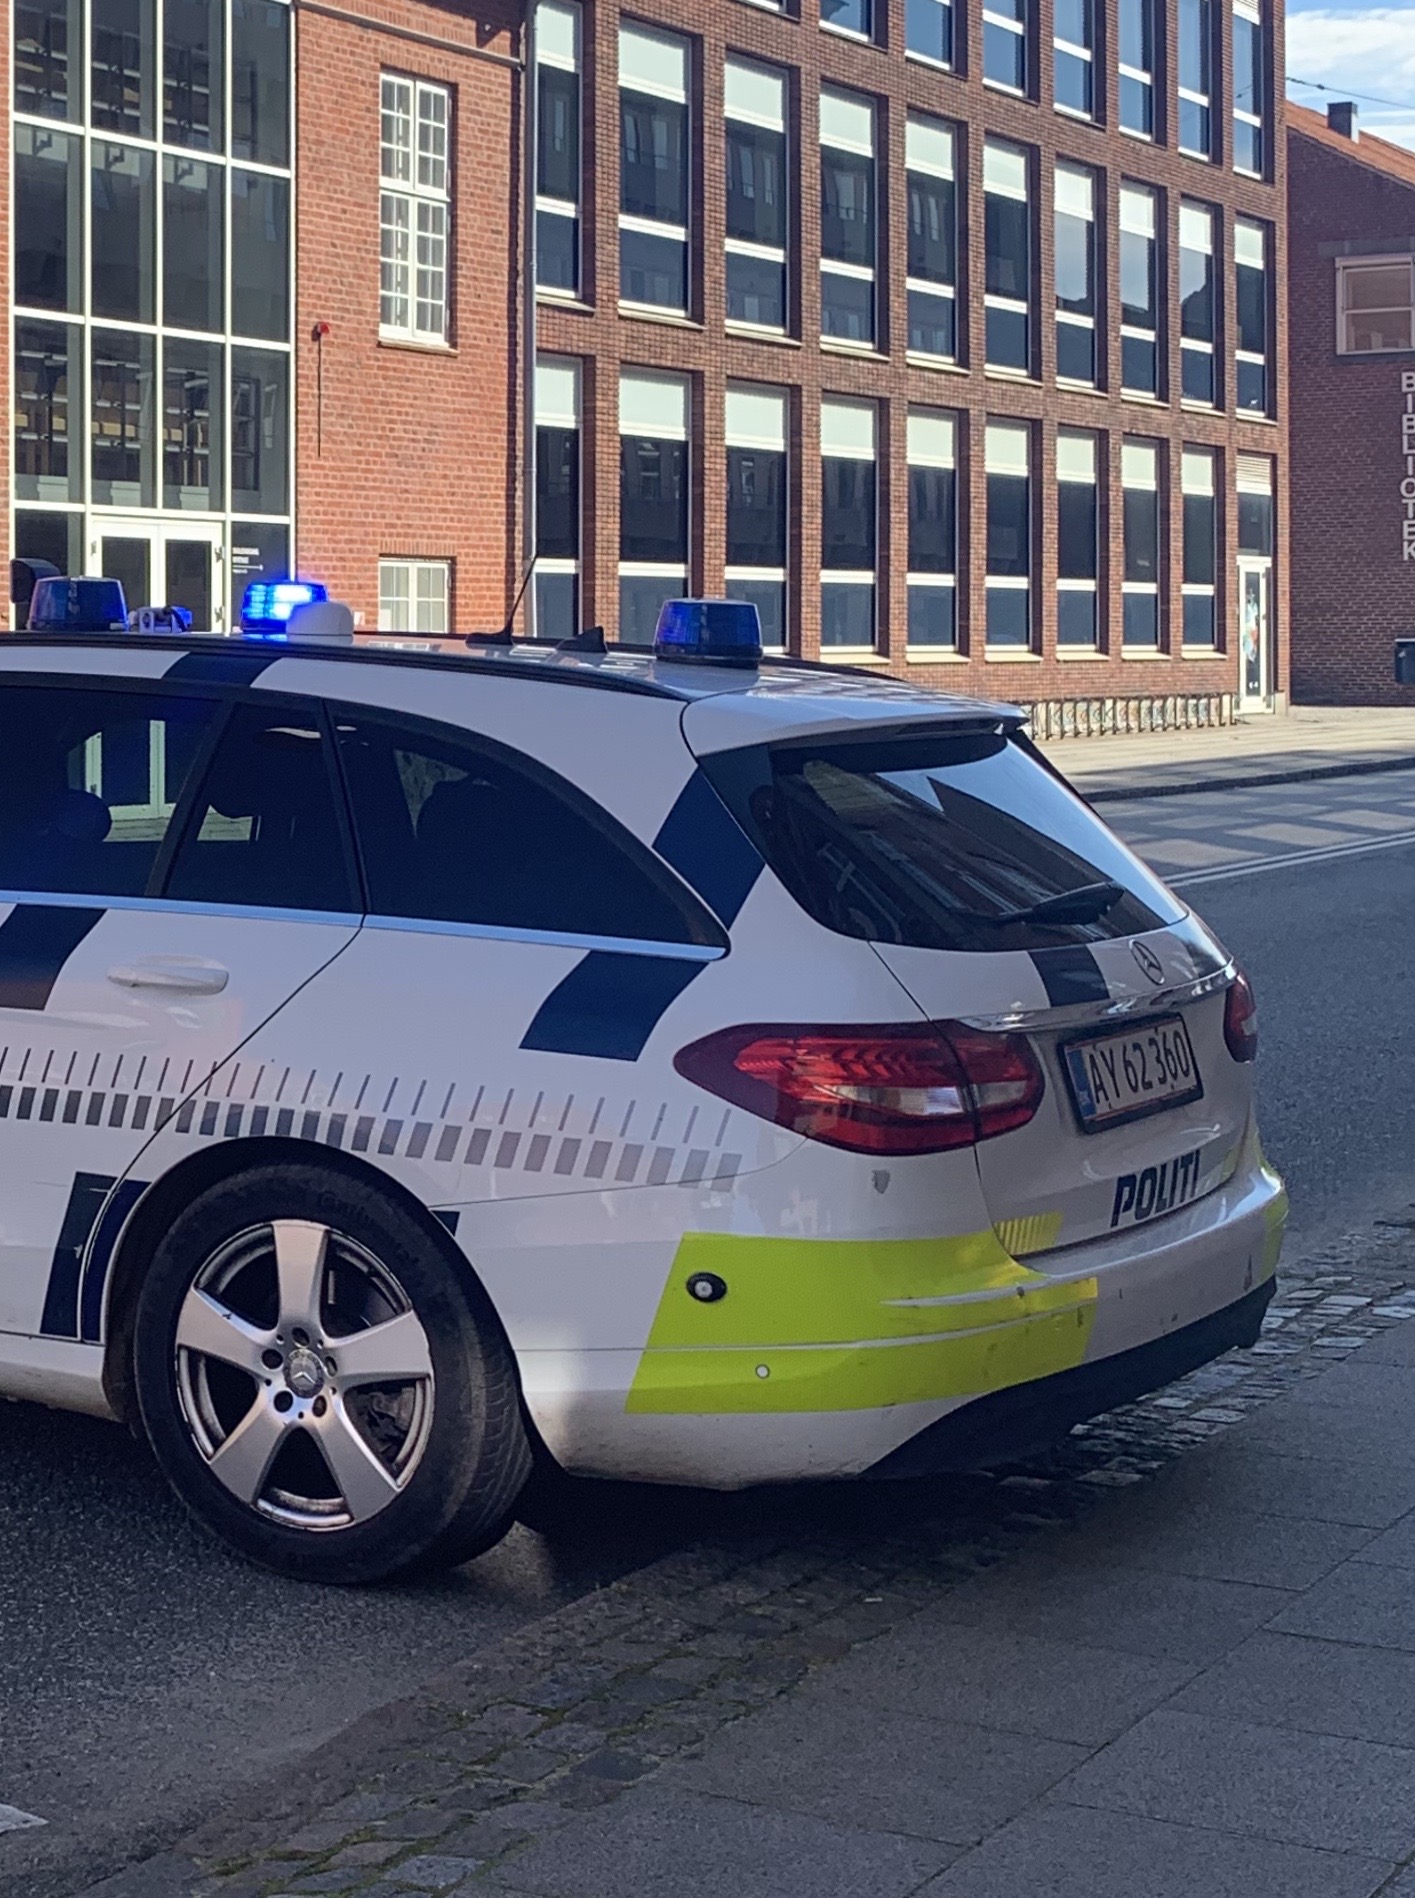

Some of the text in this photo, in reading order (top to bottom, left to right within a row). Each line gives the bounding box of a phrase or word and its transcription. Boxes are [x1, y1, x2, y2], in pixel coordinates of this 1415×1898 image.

[1400, 371, 1415, 561] BIBLIOTEK
[1089, 1048, 1120, 1104] AY
[1110, 1149, 1200, 1228] POLITI
